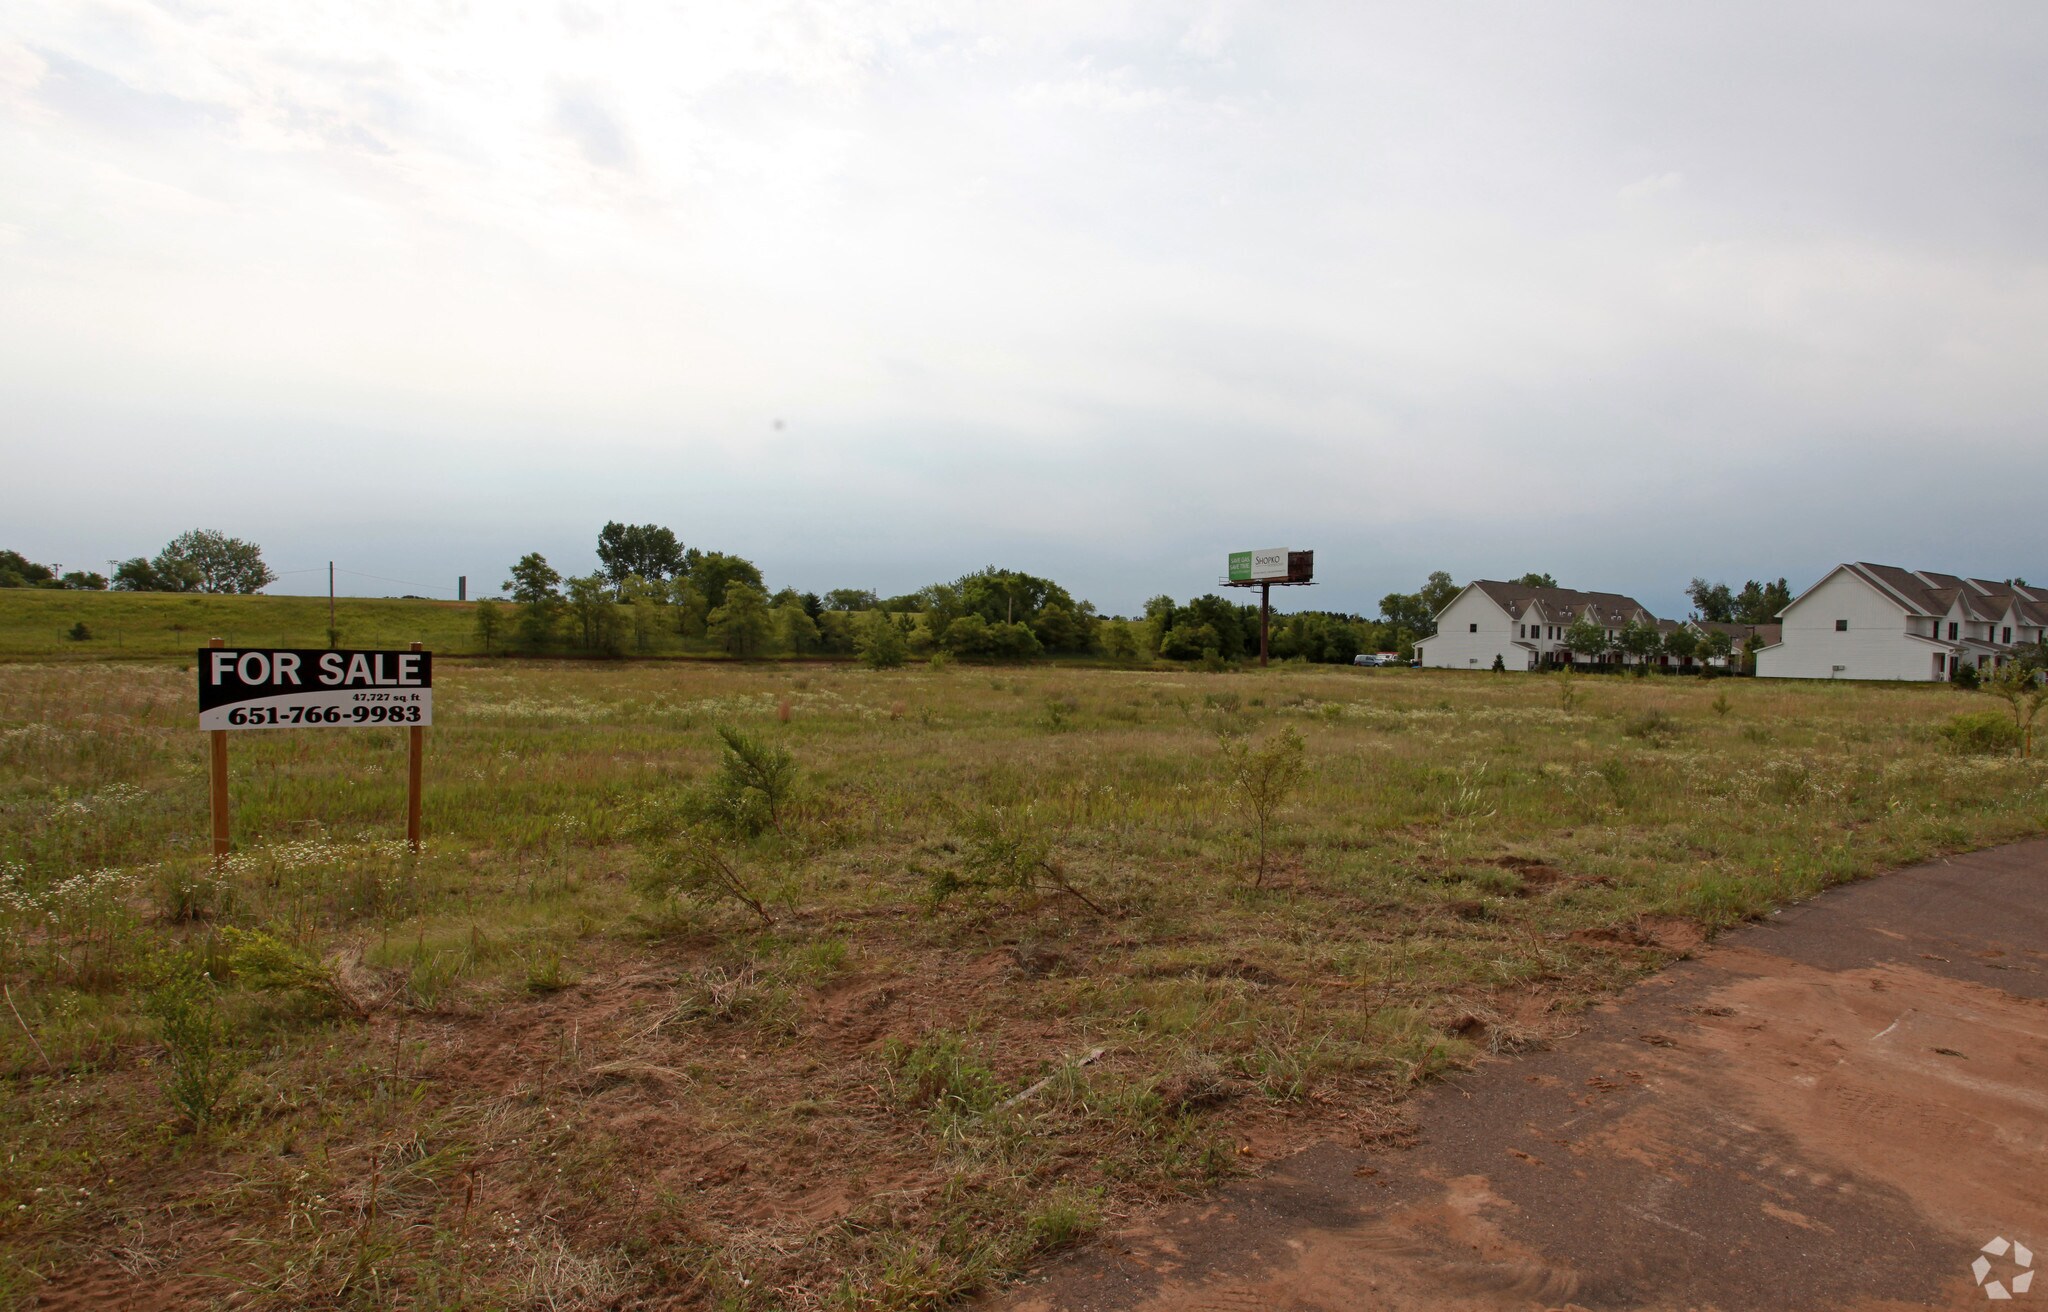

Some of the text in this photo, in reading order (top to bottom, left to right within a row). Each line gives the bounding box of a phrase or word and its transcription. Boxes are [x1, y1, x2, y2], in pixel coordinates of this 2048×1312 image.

[211, 652, 422, 686] FOR SALE
[352, 693, 390, 702] 47,727
[228, 705, 421, 725] 651-766-9983
